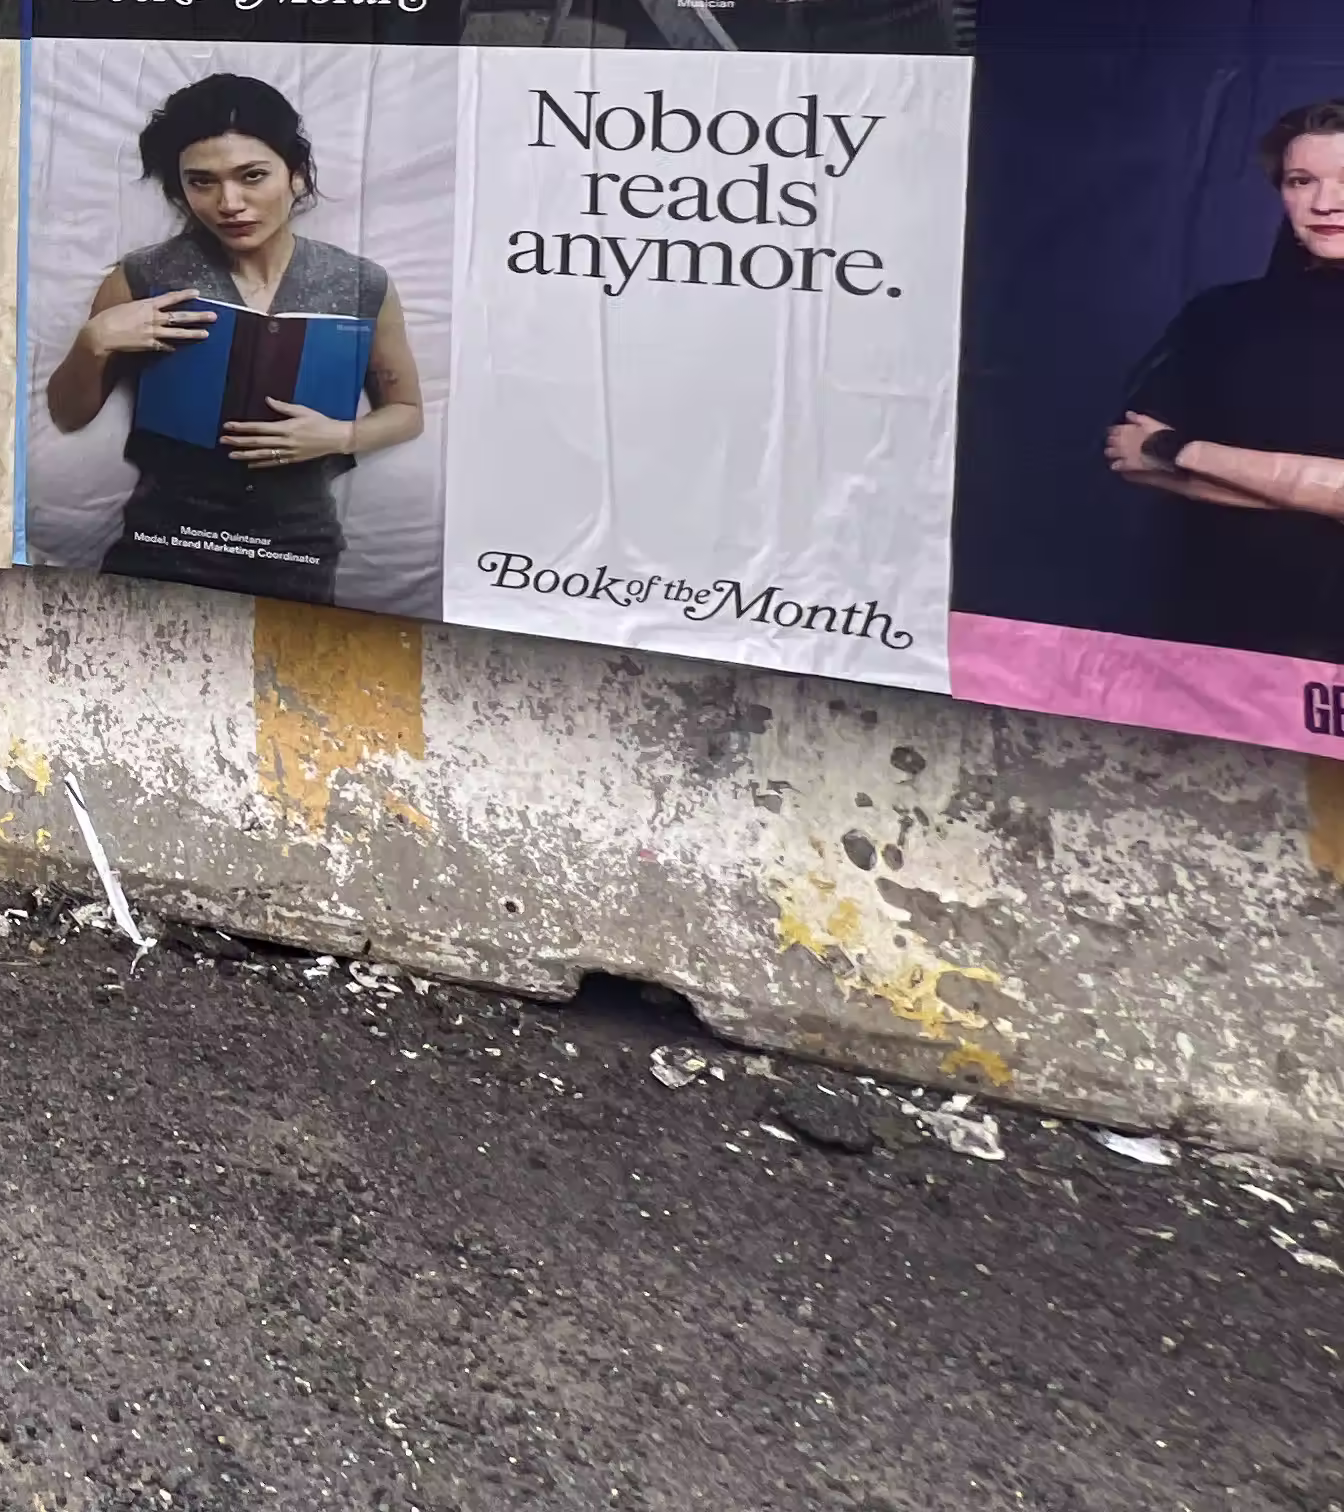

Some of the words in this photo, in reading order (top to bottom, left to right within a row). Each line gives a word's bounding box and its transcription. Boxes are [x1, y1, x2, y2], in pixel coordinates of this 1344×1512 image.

[527, 88, 887, 178] Nobody
[580, 163, 818, 228] reads
[507, 228, 902, 299] anymore.
[134, 531, 169, 546] Model,
[171, 536, 201, 549] Brand
[203, 540, 255, 558] Marketing
[257, 548, 321, 565] Coordinator
[180, 525, 218, 539] Monica
[220, 531, 272, 546] Quintanar
[477, 551, 632, 608] Book
[625, 575, 663, 604] of
[664, 579, 711, 606] the
[684, 578, 914, 651] Month
